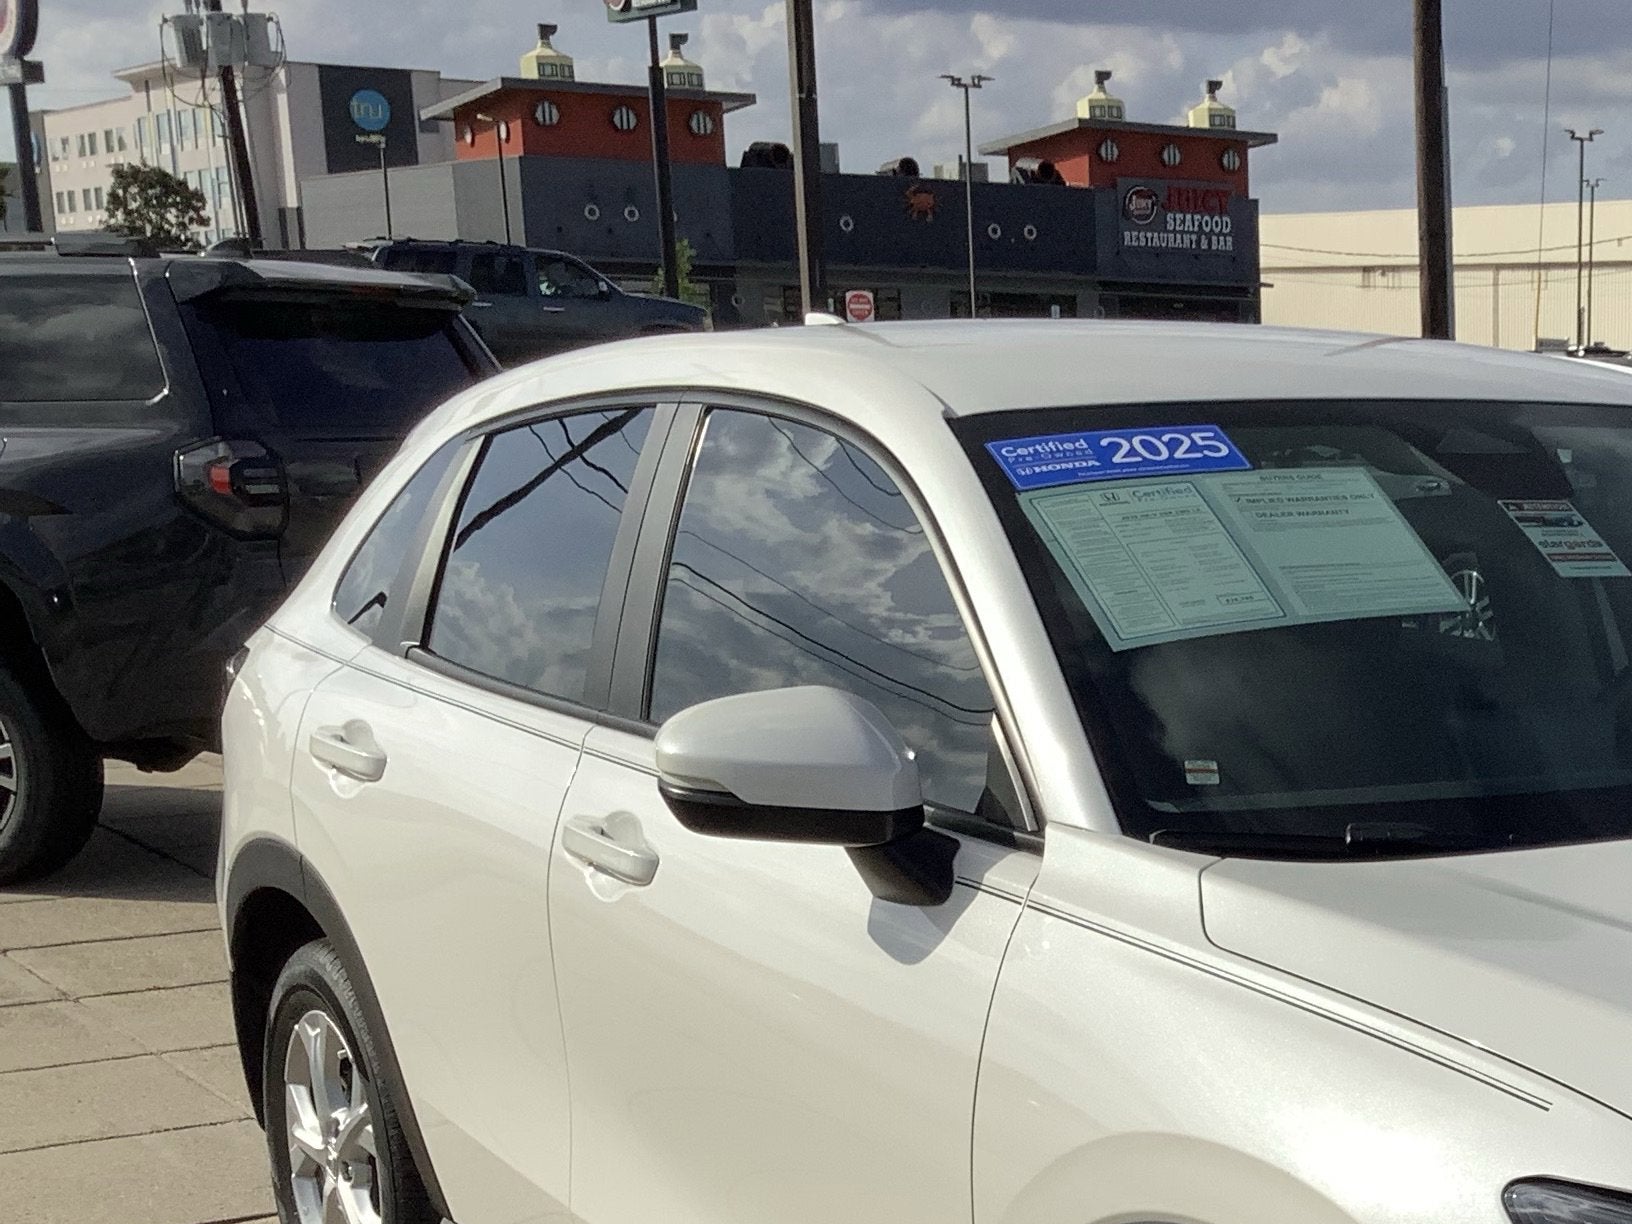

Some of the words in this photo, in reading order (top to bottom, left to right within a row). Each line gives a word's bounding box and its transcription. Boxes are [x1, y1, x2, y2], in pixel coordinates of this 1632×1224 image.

[350, 96, 383, 119] tru
[1161, 186, 1231, 215] JUICY
[1166, 212, 1232, 234] SEAFOOD
[1124, 231, 1198, 249] RESTAURANT
[1200, 235, 1209, 249] &
[1211, 236, 1233, 251] BAR
[1001, 438, 1088, 457] Certified
[1100, 432, 1230, 464] 2025
[1032, 460, 1102, 474] HONDA
[1132, 486, 1193, 498] Certified
[1286, 495, 1349, 503] WARRANTIES
[1349, 493, 1376, 501] ONLY
[1255, 511, 1295, 519] DEALER
[1296, 509, 1350, 518] WARRANTY
